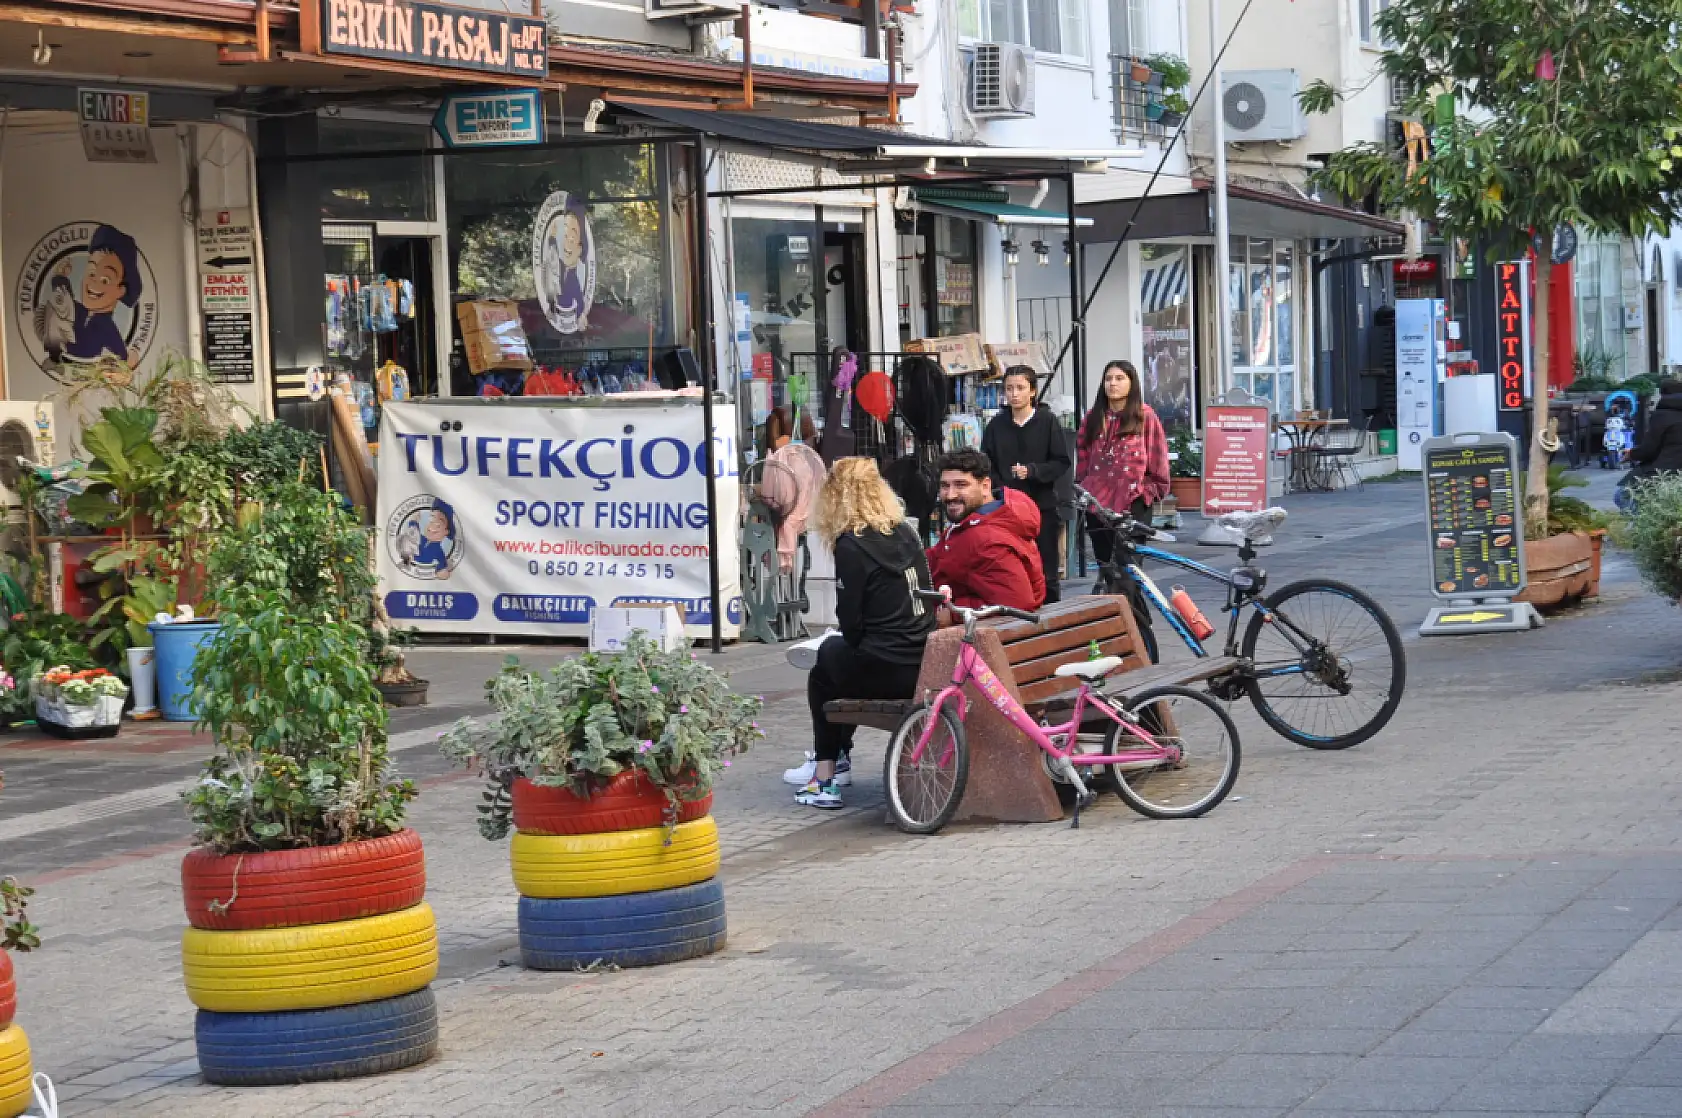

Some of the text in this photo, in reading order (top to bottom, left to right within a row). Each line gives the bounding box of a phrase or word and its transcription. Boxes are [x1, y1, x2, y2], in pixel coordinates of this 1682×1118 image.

[331, 0, 508, 66] ERKİN PASAJ
[82, 92, 142, 122] EMRE
[207, 275, 244, 284] EMLAK
[203, 285, 249, 296] FETHİYE
[495, 500, 709, 530] SPORT FISHING
[494, 540, 709, 558] www.balikciburada.com
[528, 561, 674, 579] 0 850 214 35 15
